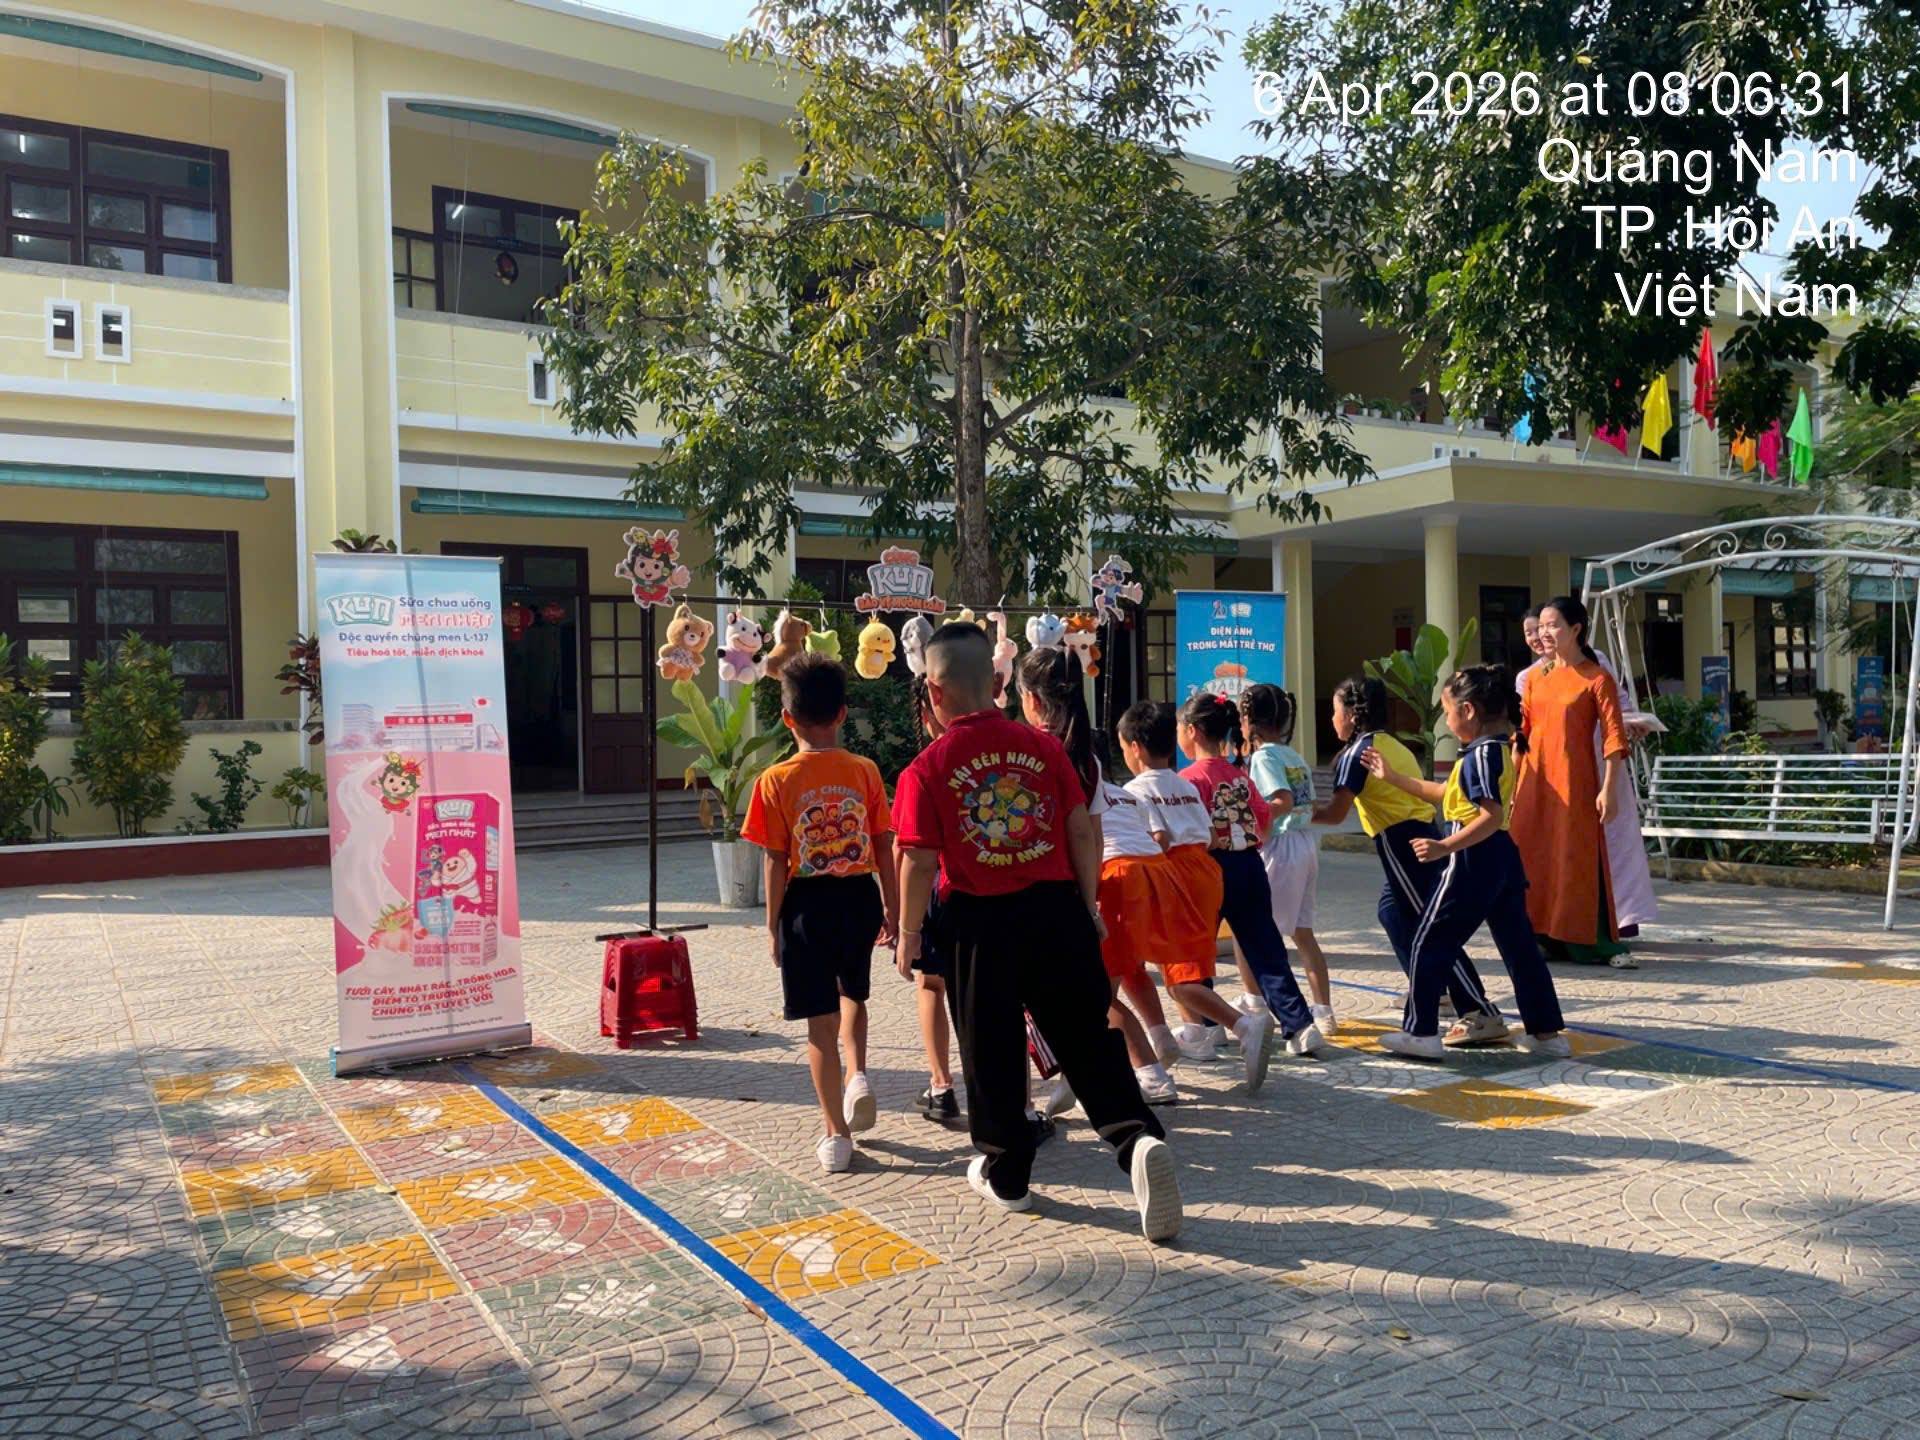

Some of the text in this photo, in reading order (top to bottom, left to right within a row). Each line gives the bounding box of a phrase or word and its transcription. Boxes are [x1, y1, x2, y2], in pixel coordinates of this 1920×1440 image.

[428, 596, 458, 608] chua
[461, 597, 491, 610] uống
[1187, 640, 1217, 651] TRONG
[971, 752, 1000, 770] BÊN
[1006, 751, 1045, 773] NHAU
[494, 967, 516, 978] HOA
